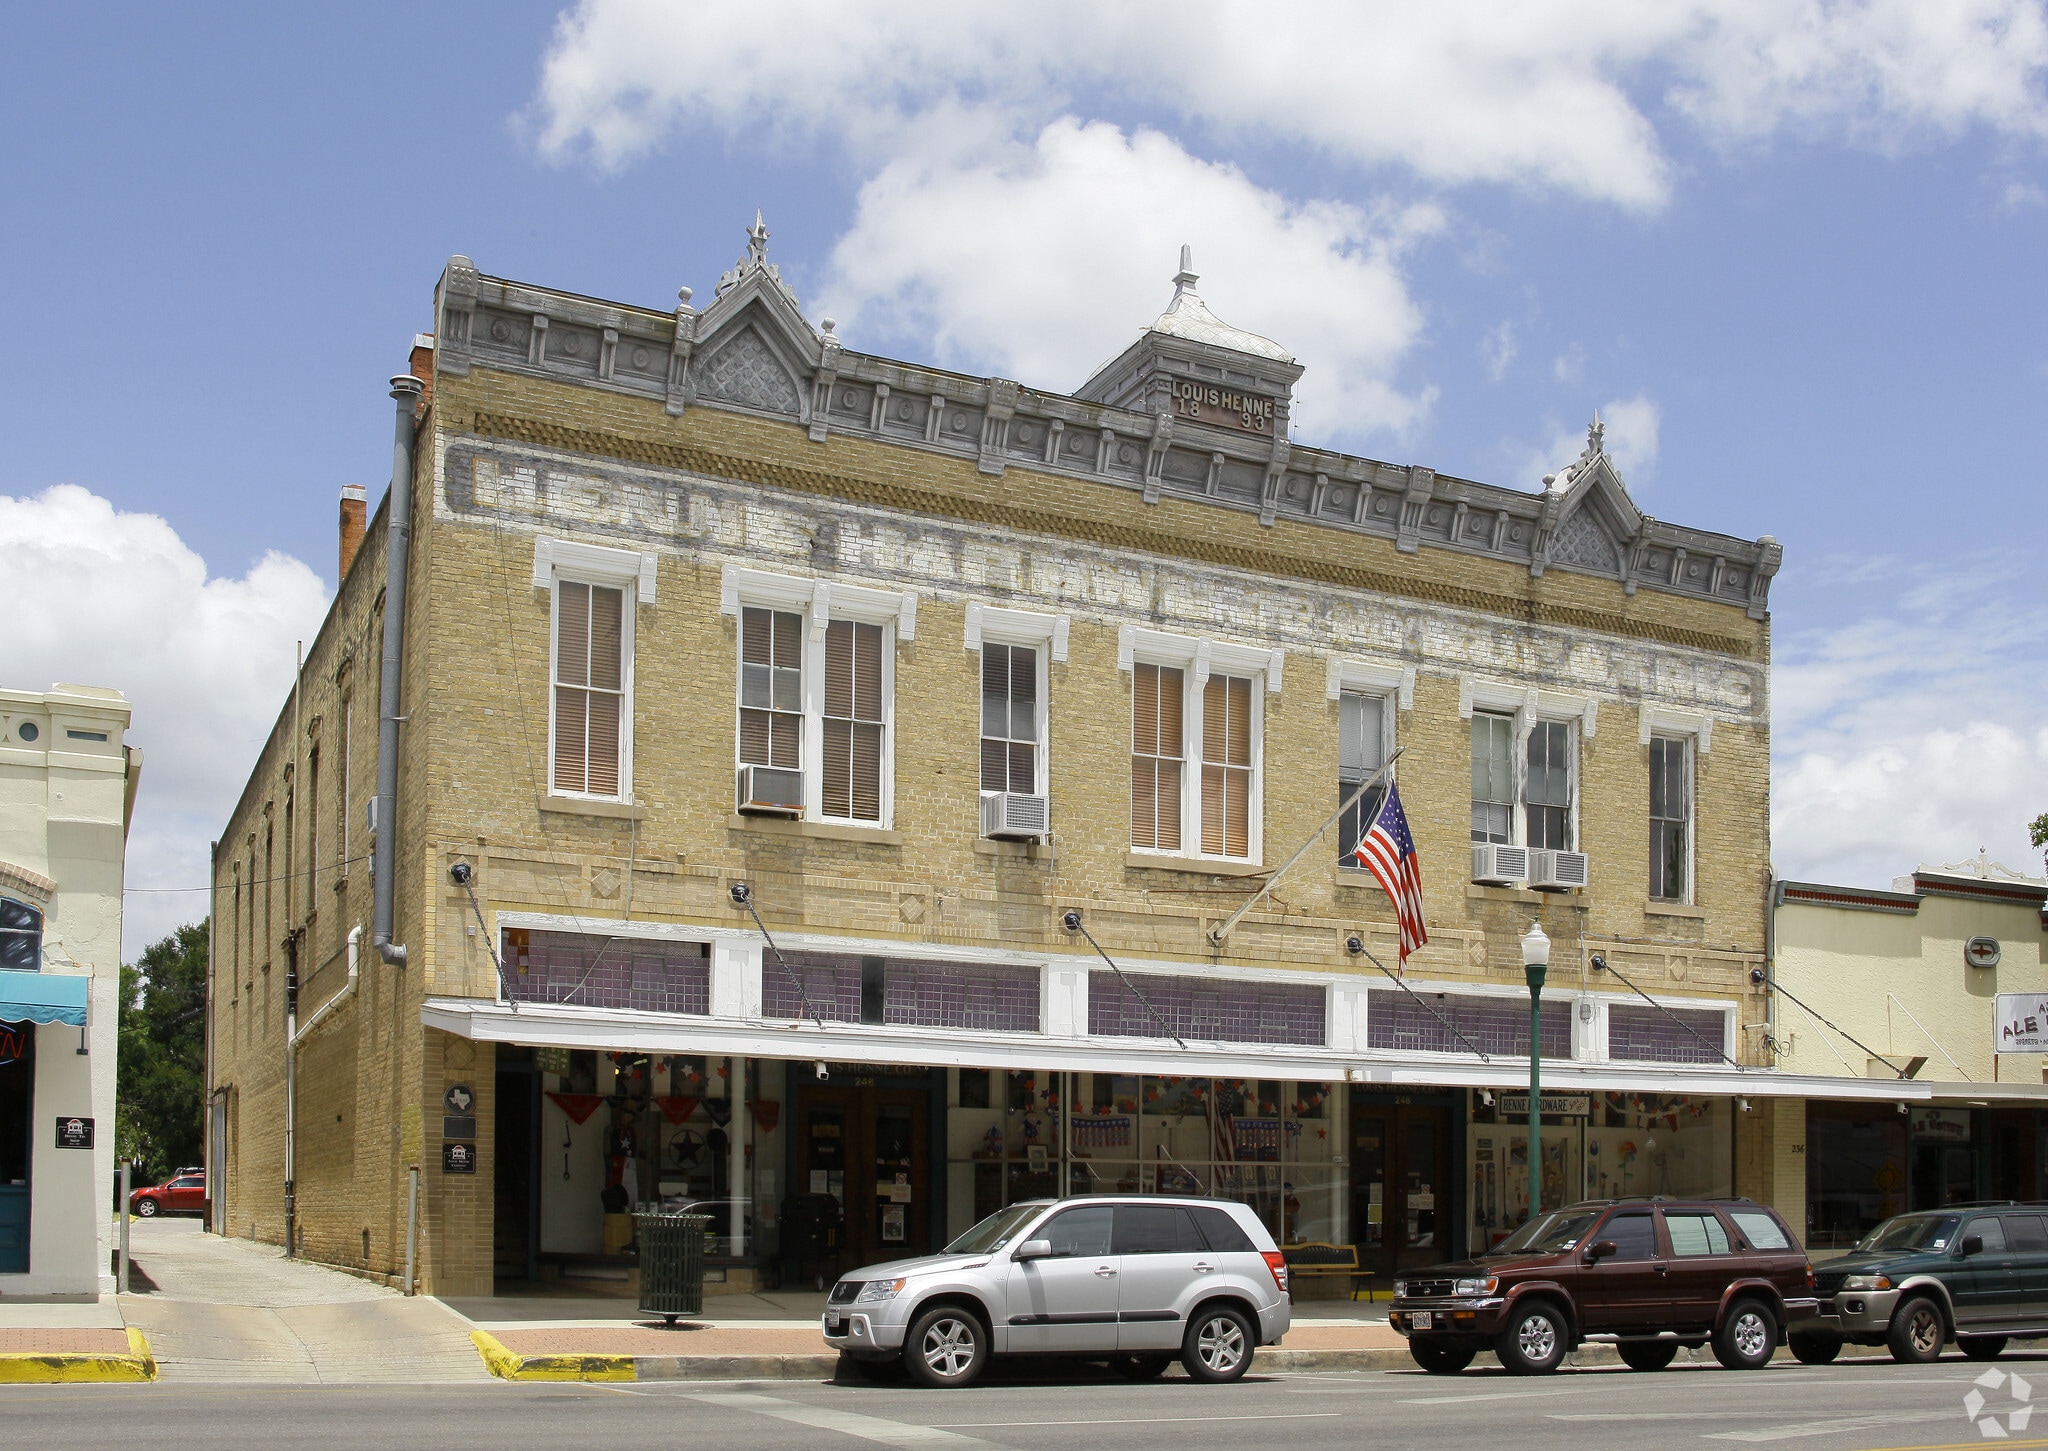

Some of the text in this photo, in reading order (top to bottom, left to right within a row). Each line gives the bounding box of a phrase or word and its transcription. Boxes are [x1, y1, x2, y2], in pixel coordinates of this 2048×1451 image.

[1172, 381, 1273, 419] LOUIS HENNE
[1178, 398, 1265, 431] 18 93
[2003, 1016, 2039, 1041] ALE
[848, 1063, 891, 1075] HENNE
[1503, 1098, 1568, 1112] HENNE RDWARE
